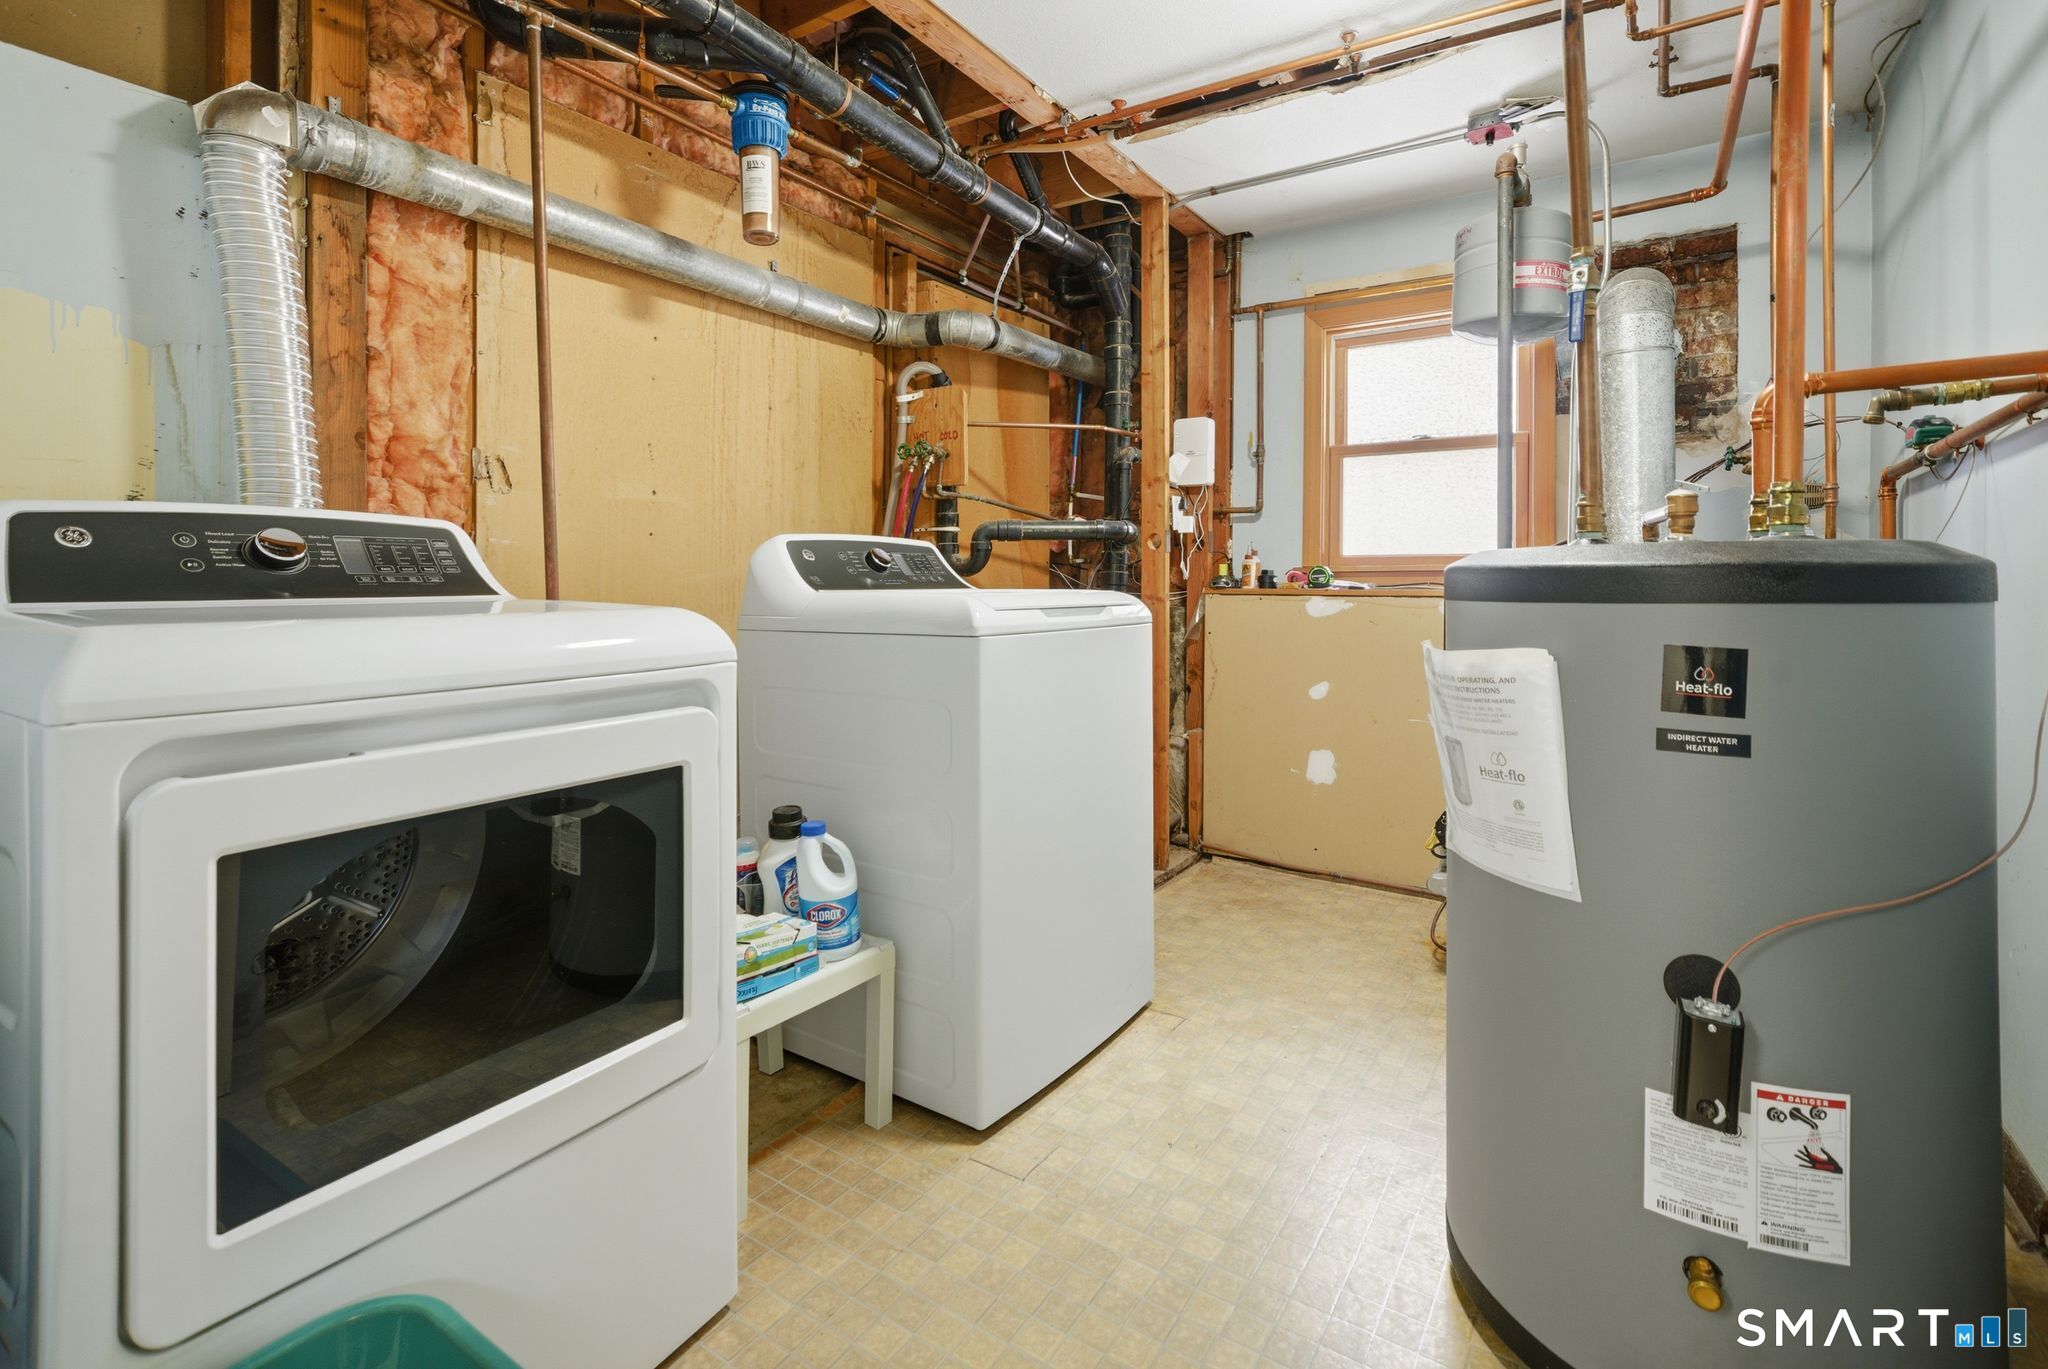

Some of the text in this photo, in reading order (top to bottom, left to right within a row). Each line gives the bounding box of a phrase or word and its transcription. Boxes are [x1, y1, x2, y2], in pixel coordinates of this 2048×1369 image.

[913, 430, 958, 441] HOT COLD
[1498, 676, 1517, 685] AND
[1675, 680, 1733, 696] Heat-flo
[1667, 733, 1738, 746] INDIRECT WATER
[1685, 743, 1719, 753] HEATER
[1479, 765, 1526, 782] Heat-flo
[810, 908, 842, 921] CLOROX
[1788, 1095, 1829, 1106] DANGER
[1770, 1221, 1806, 1233] WARNING
